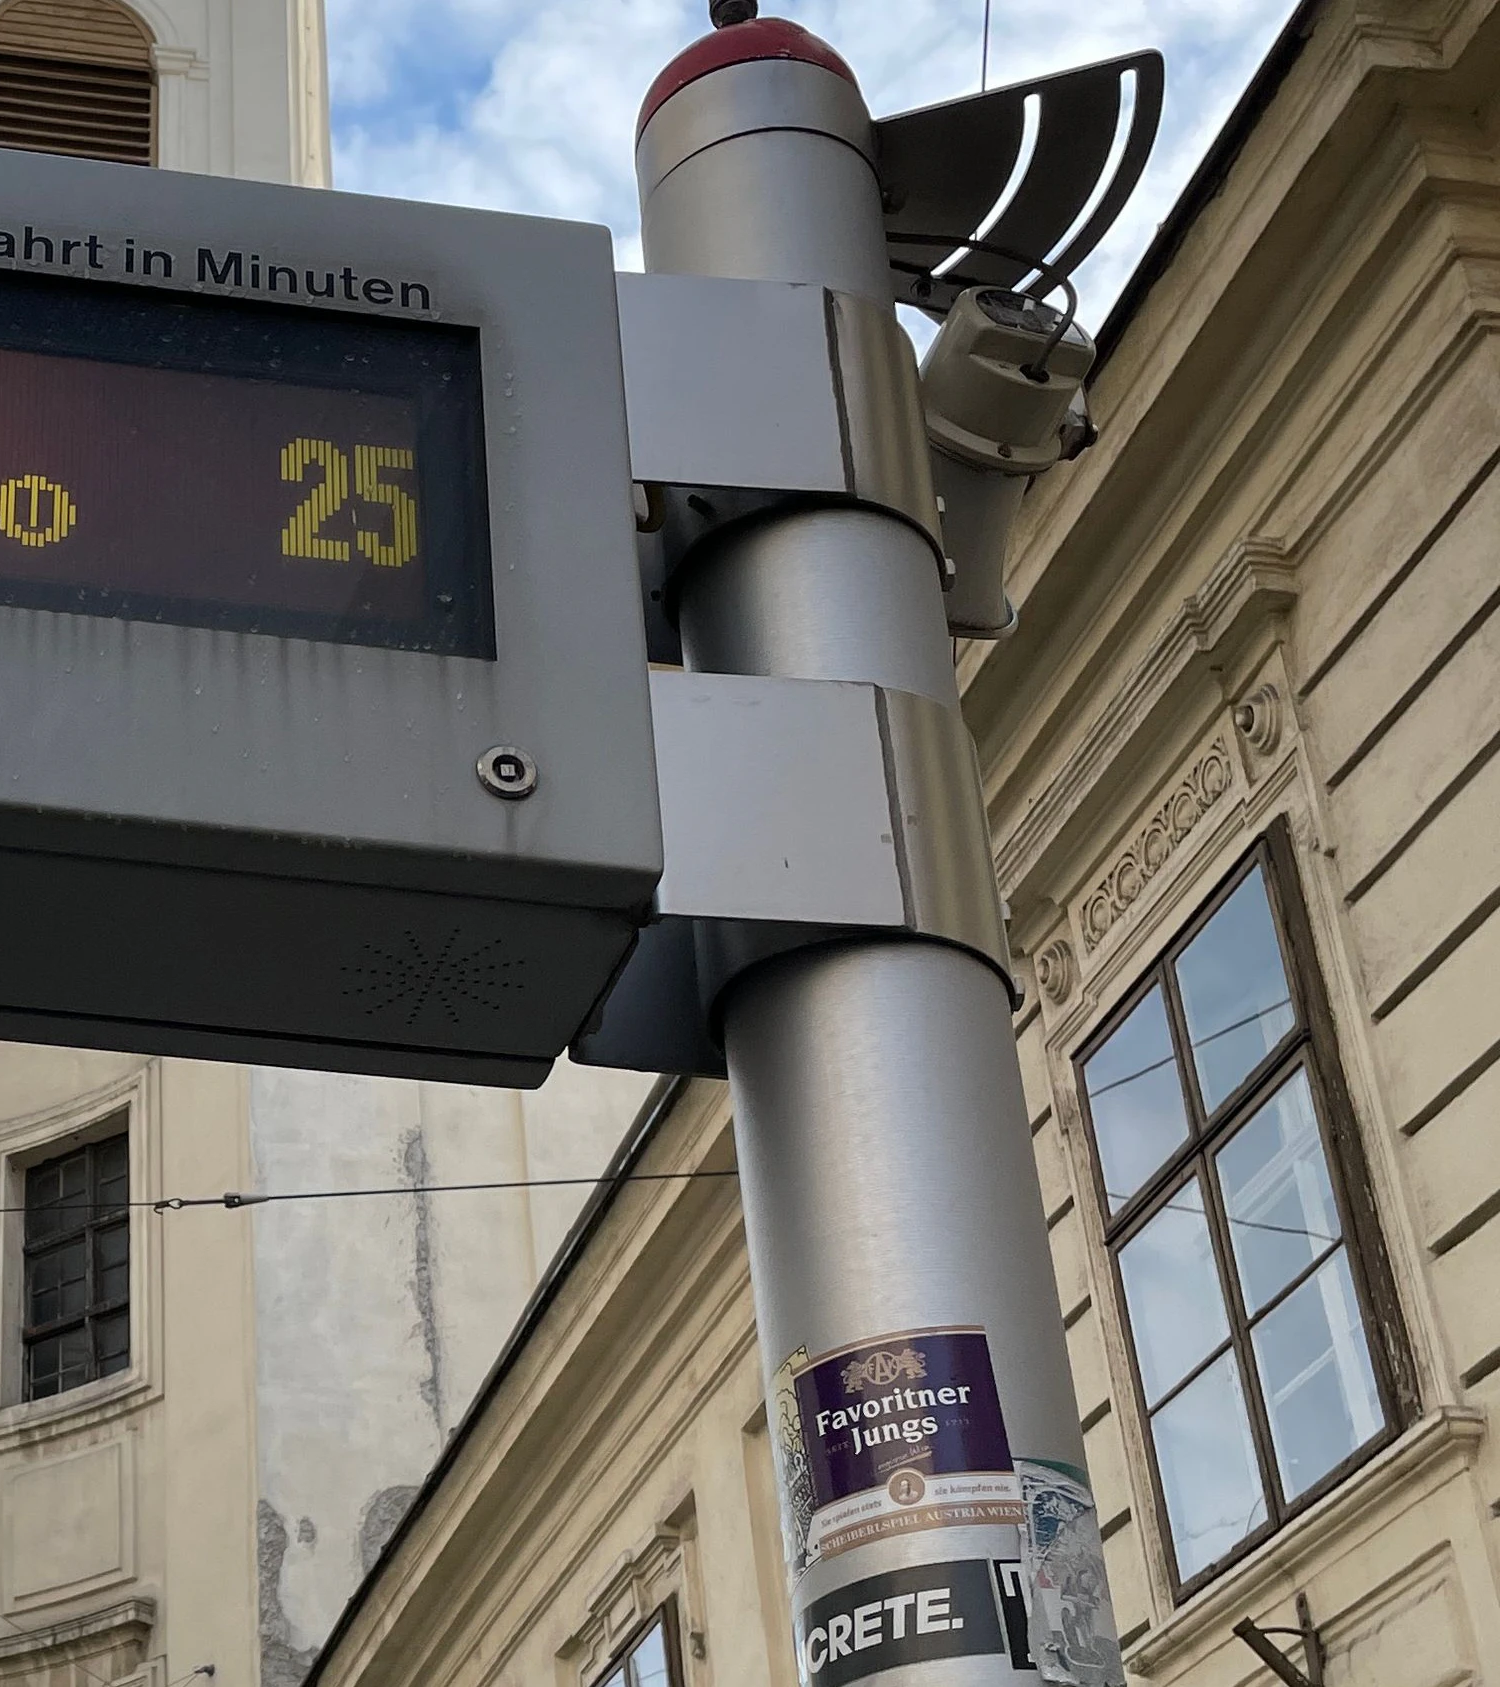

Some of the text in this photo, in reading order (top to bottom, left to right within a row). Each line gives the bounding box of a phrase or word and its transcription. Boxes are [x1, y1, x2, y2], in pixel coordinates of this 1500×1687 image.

[125, 239, 173, 277] in
[198, 247, 432, 311] Minuten
[280, 437, 418, 567] 25
[815, 1385, 971, 1437] Favoritner
[851, 1416, 938, 1455] Jungs
[925, 1507, 985, 1521] AUSTRIA
[987, 1506, 1022, 1517] WIEN
